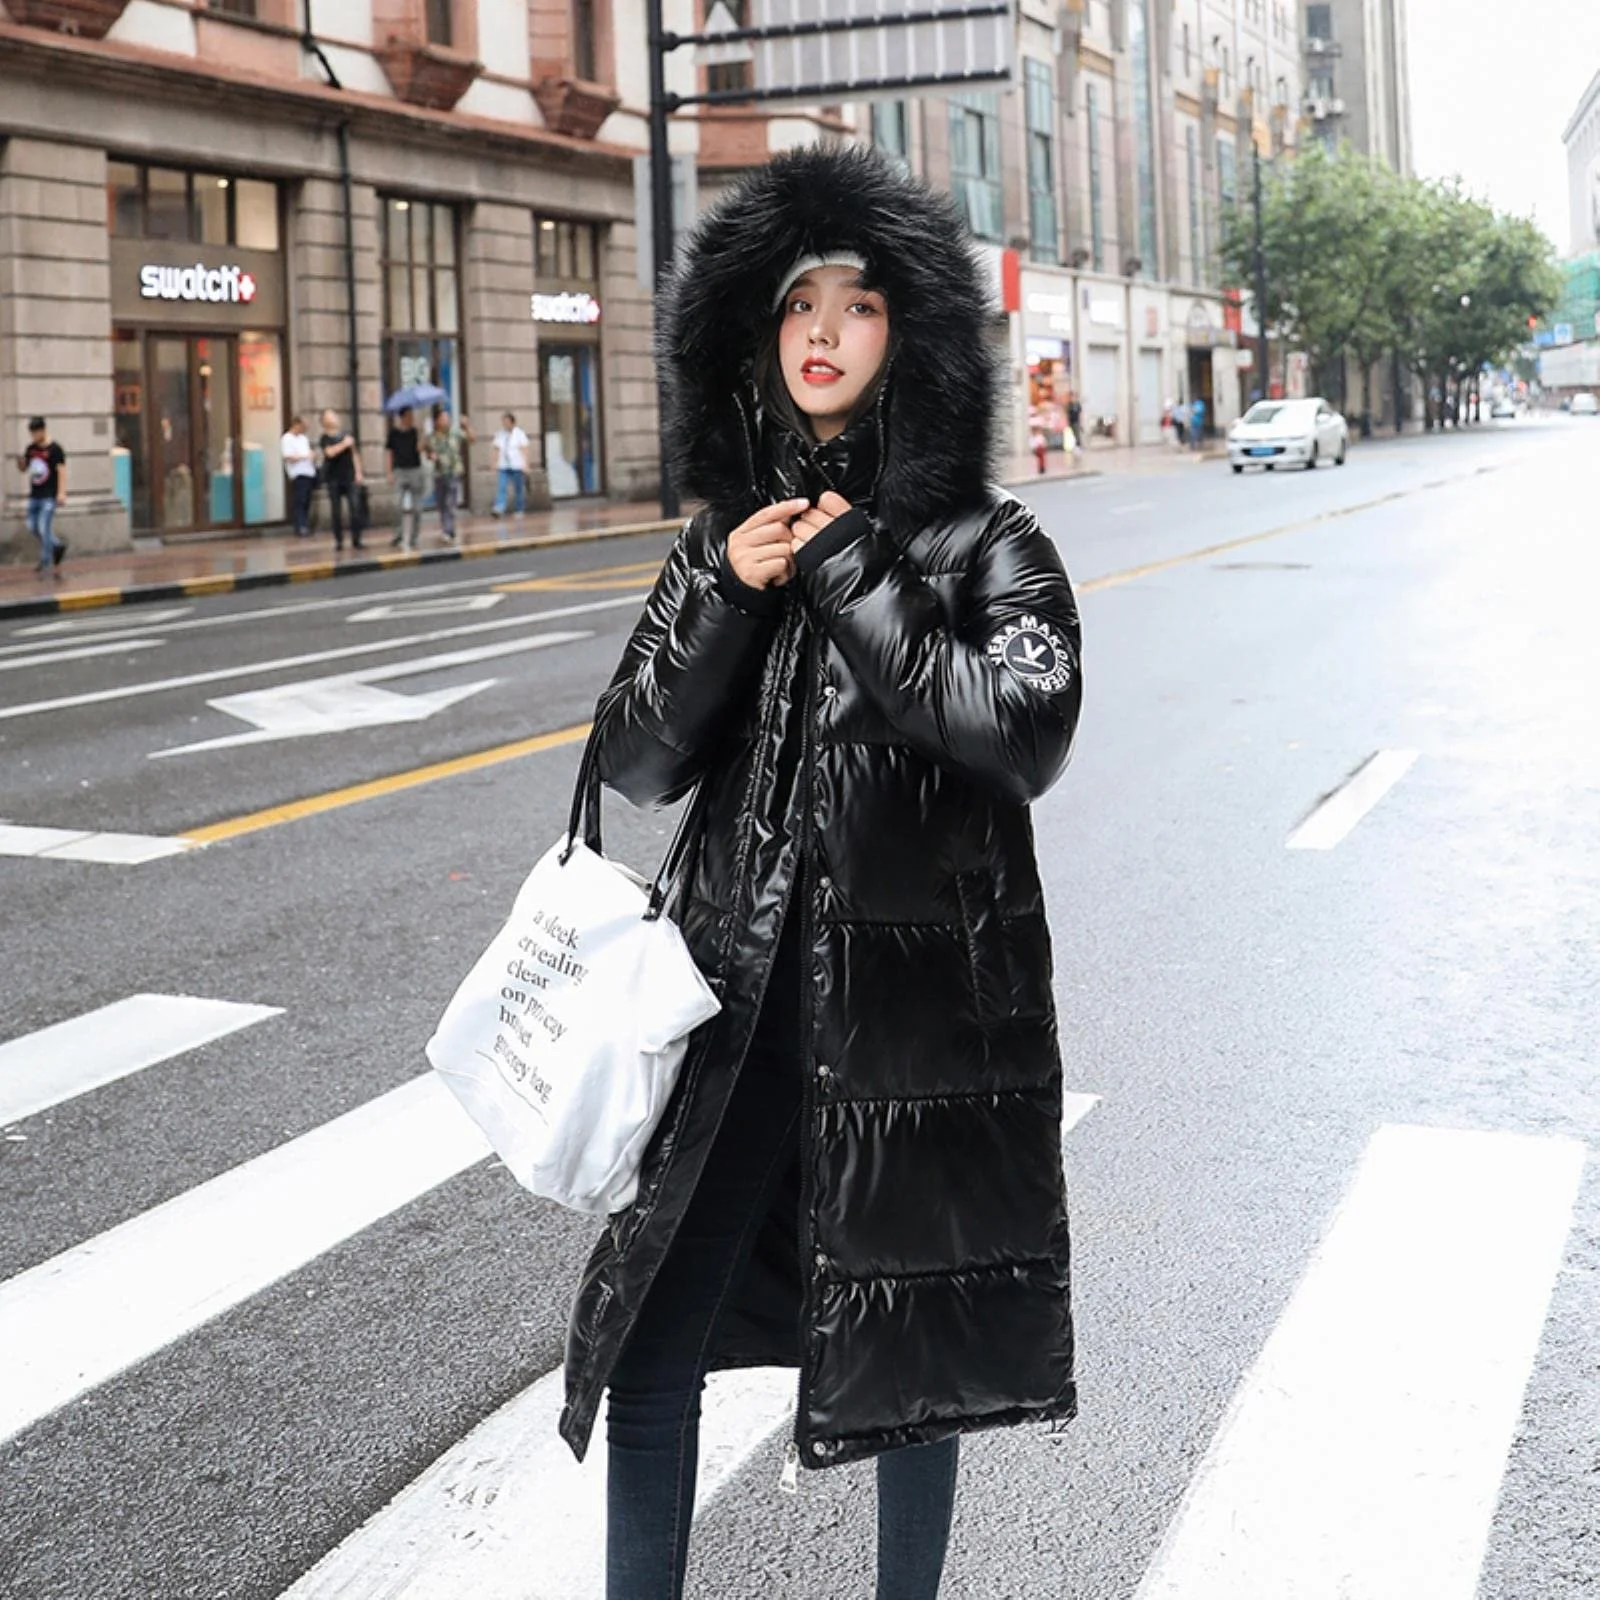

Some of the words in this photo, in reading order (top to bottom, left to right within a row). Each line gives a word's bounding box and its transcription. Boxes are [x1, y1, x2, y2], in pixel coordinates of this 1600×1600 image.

[140, 263, 239, 302] swatch
[506, 958, 550, 991] clear
[500, 986, 527, 1005] on
